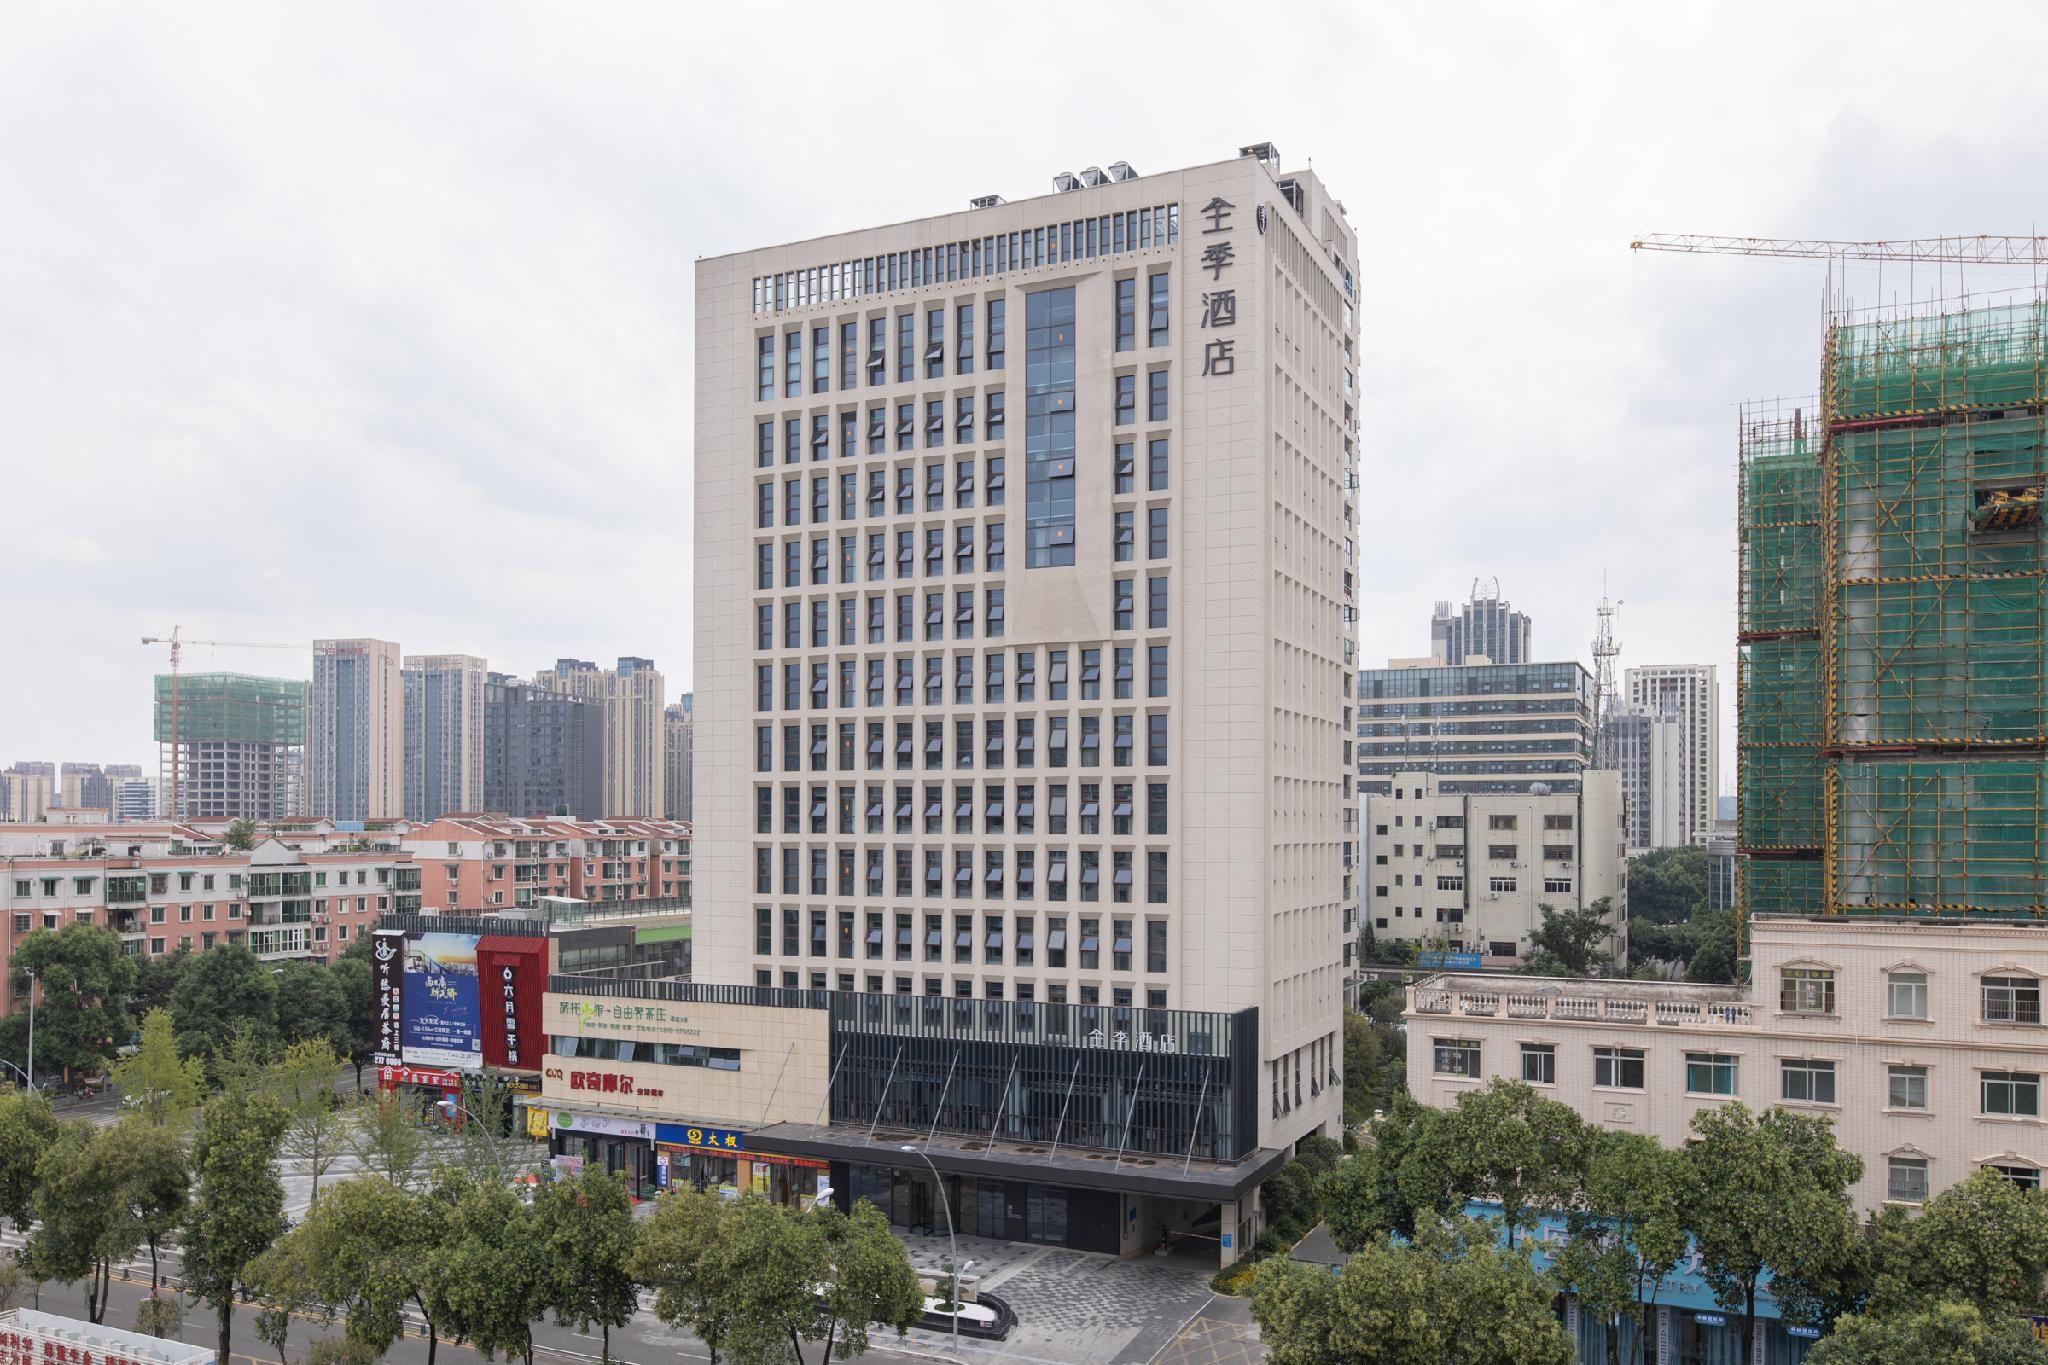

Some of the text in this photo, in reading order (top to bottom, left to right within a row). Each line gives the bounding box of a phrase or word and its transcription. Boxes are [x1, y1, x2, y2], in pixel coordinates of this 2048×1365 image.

[1200, 196, 1236, 376] 全季酒店
[1088, 1028, 1176, 1053] 全季酒店
[570, 1070, 634, 1095] 欧奇摩尔
[707, 1131, 738, 1148] 太极
